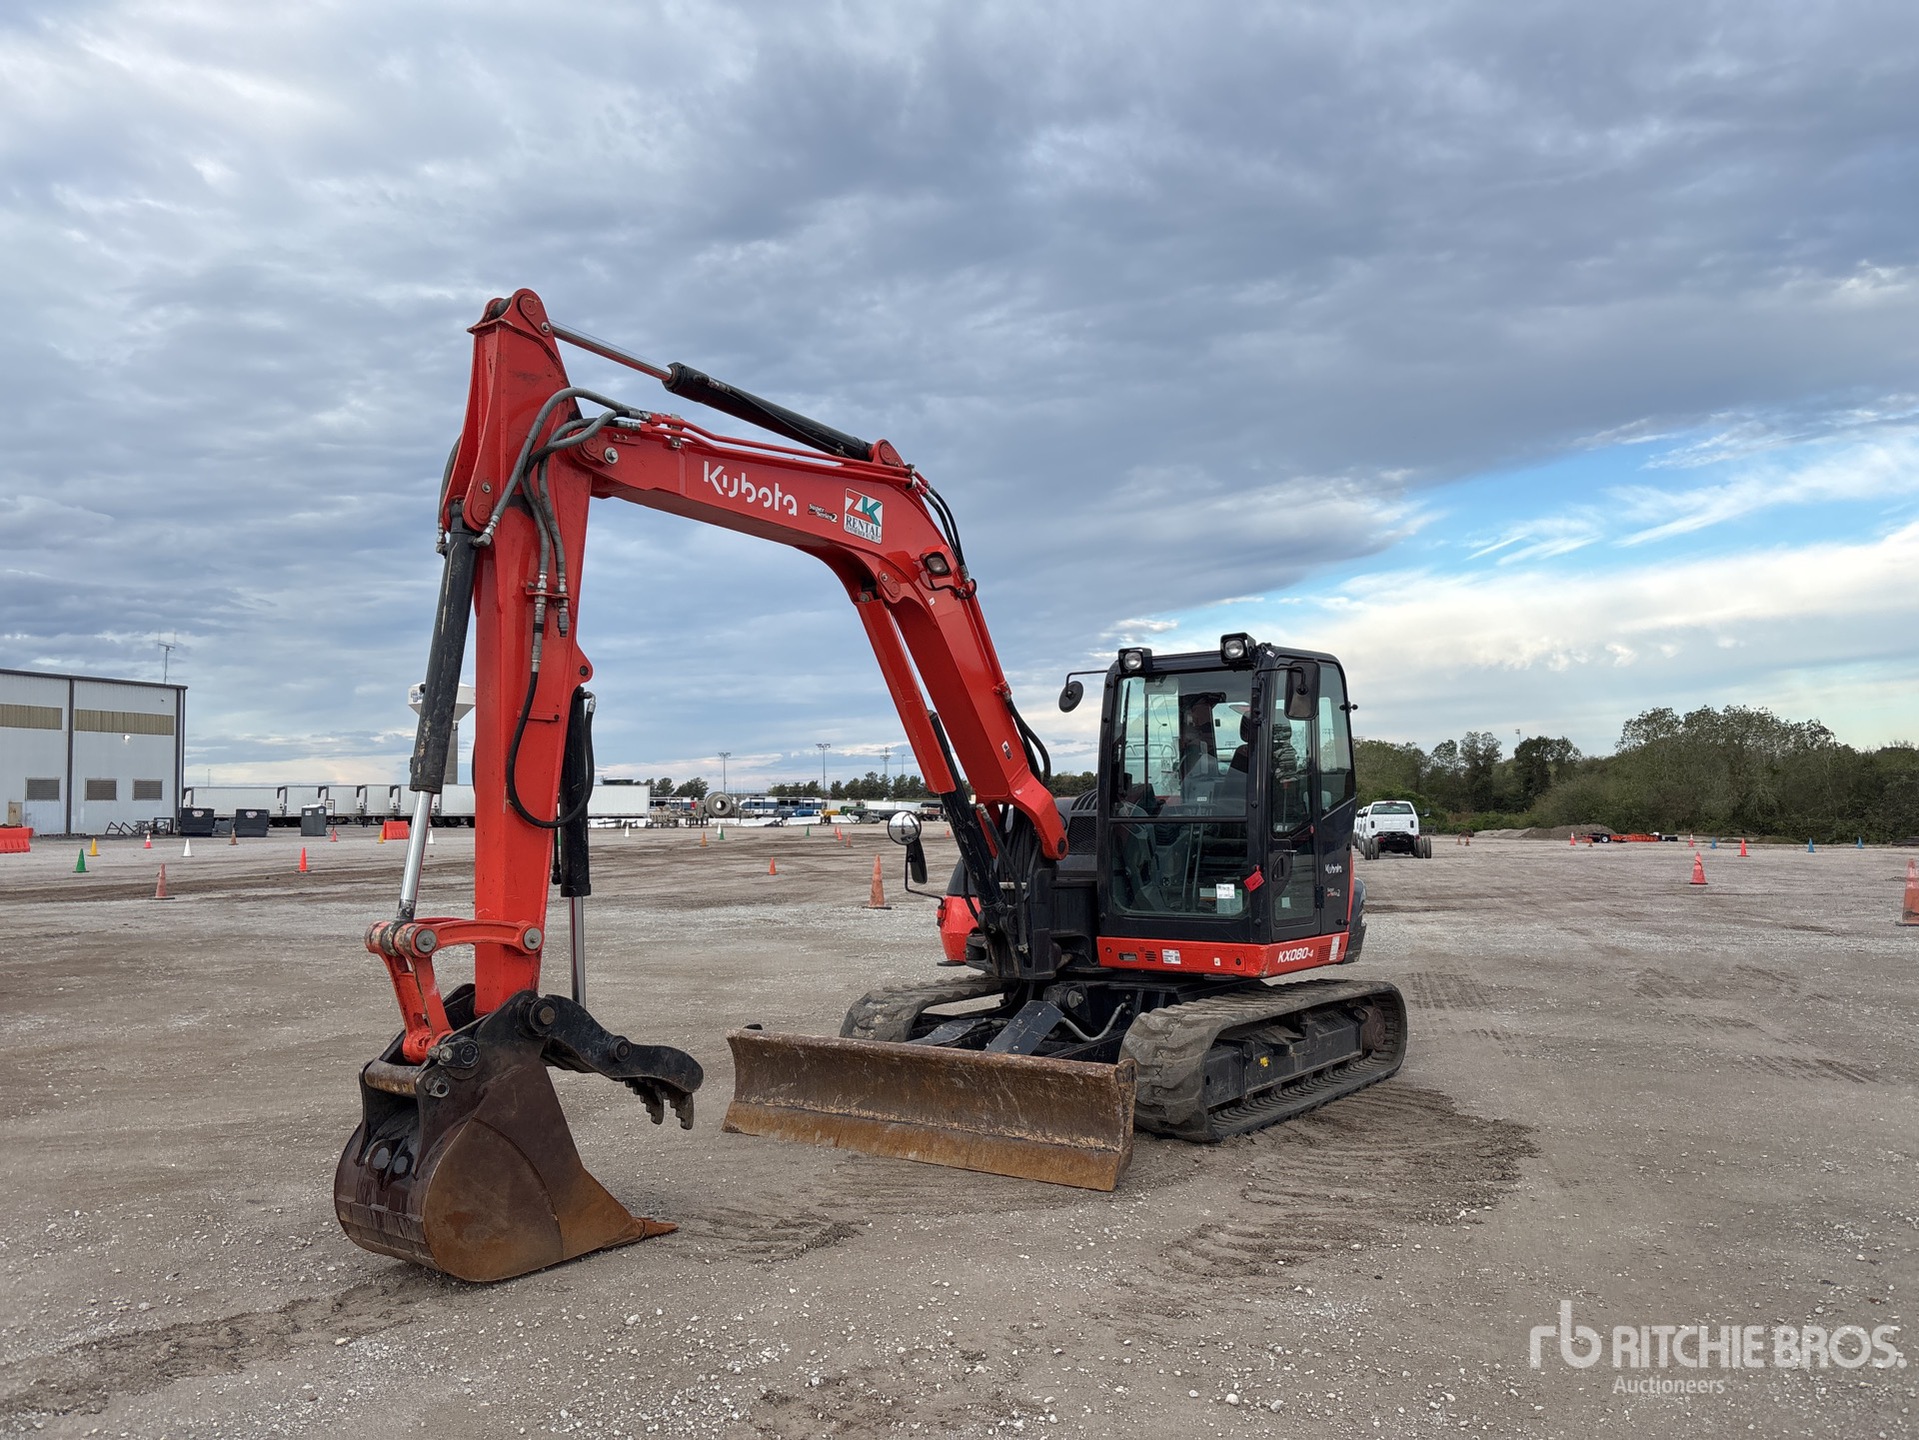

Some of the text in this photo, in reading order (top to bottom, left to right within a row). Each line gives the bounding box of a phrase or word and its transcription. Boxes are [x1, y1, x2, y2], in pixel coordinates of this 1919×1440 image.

[703, 460, 798, 517] Kubota
[846, 490, 882, 527] ZK
[846, 515, 881, 538] RENTAL
[1277, 947, 1314, 964] KX080-4
